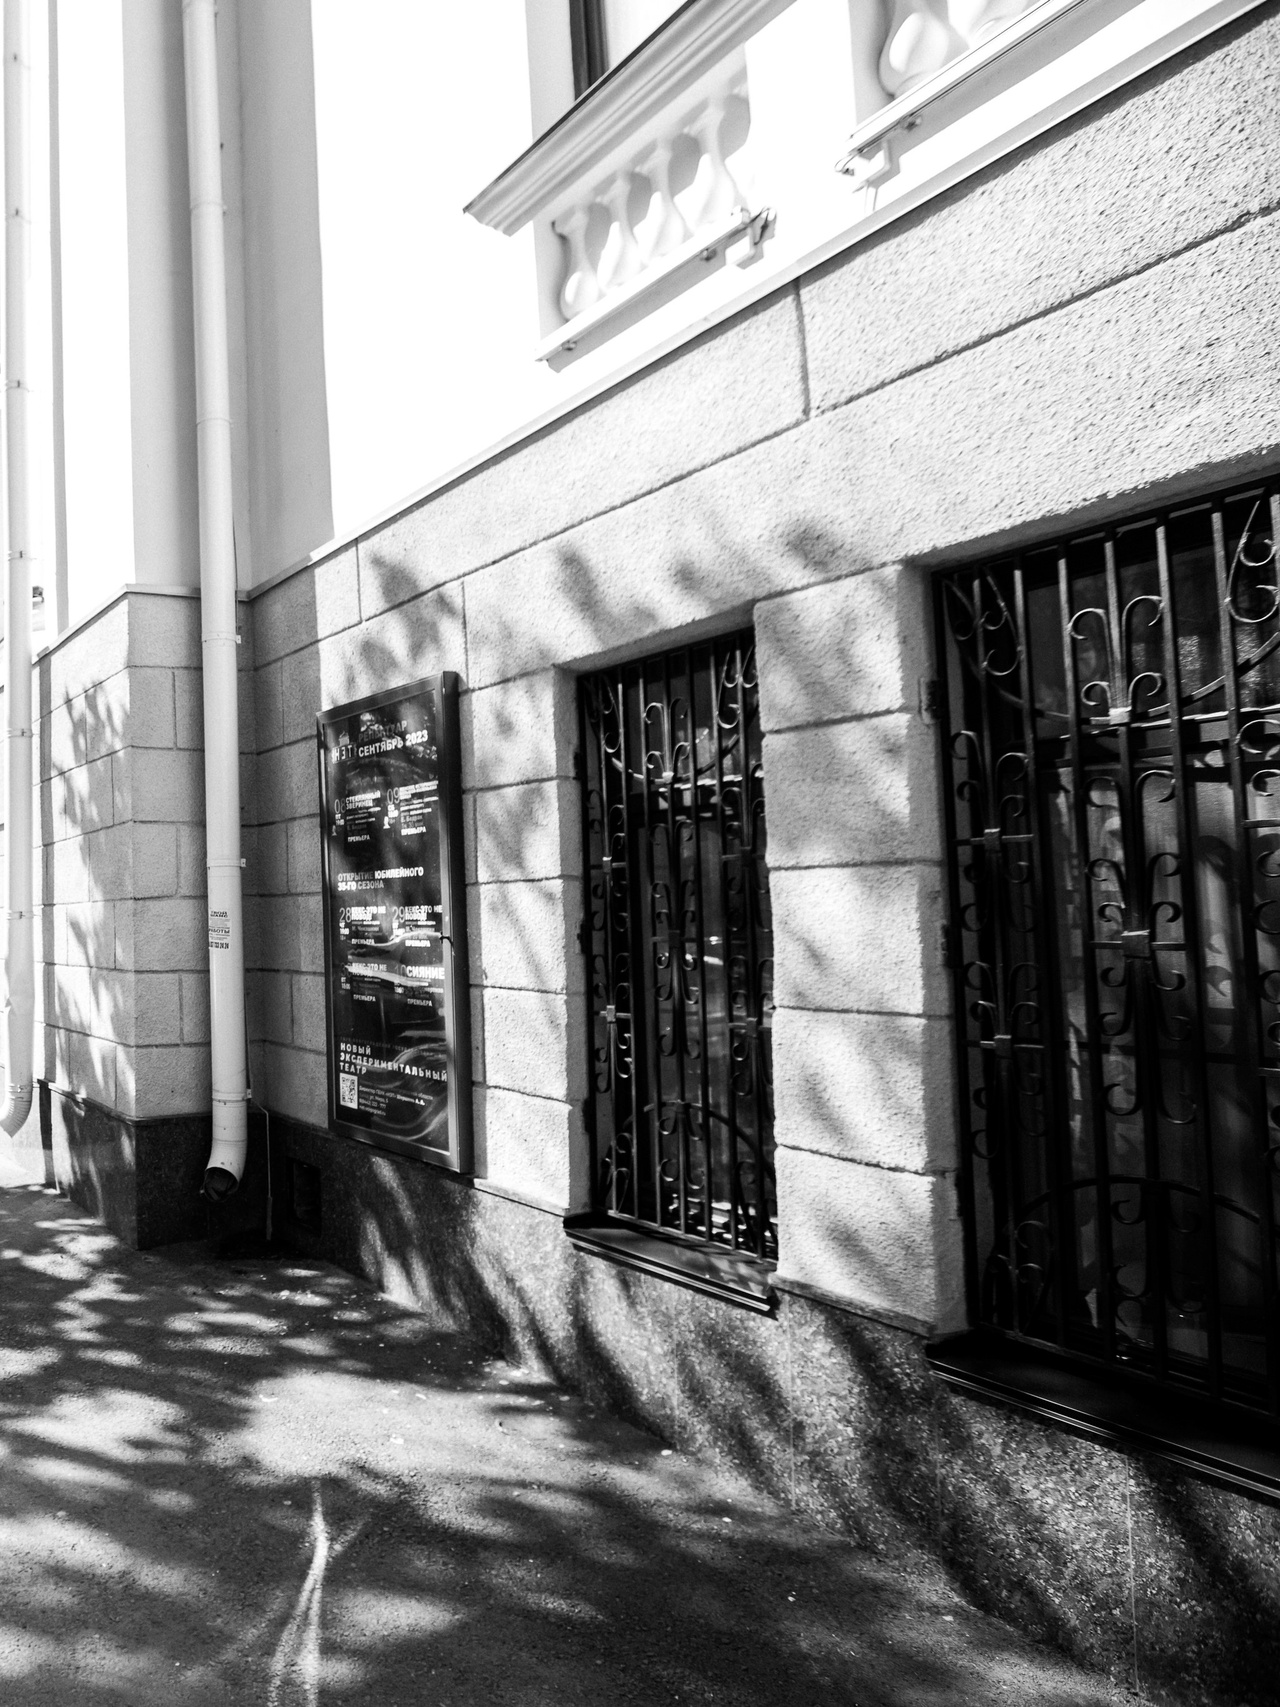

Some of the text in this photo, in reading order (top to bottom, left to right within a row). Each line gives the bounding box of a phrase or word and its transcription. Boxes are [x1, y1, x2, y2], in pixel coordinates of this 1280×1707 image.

[358, 729, 428, 758] СЕНТЯБРЬ 2023
[387, 787, 400, 805] 09
[334, 798, 346, 814] 08
[347, 834, 371, 843] ПРЕМЬЕРА
[338, 866, 424, 882] ОТКРЫТИЕ ЮБИЛЕЙНОГО
[338, 880, 385, 891] 35-ГО СЕЗОНА
[339, 907, 352, 923] 28
[392, 906, 405, 923] 29
[406, 965, 446, 980] СИЯНИЕ
[353, 994, 376, 1002] ПРЕМЬЕРА
[407, 998, 433, 1007] ПРЕМЬЕРА
[340, 1042, 371, 1055] НОВЫЙ
[339, 1052, 448, 1082] ЭКСПЕРИМЕНТАЛЬНЫЙ
[339, 1062, 367, 1075] ТЕАТР
